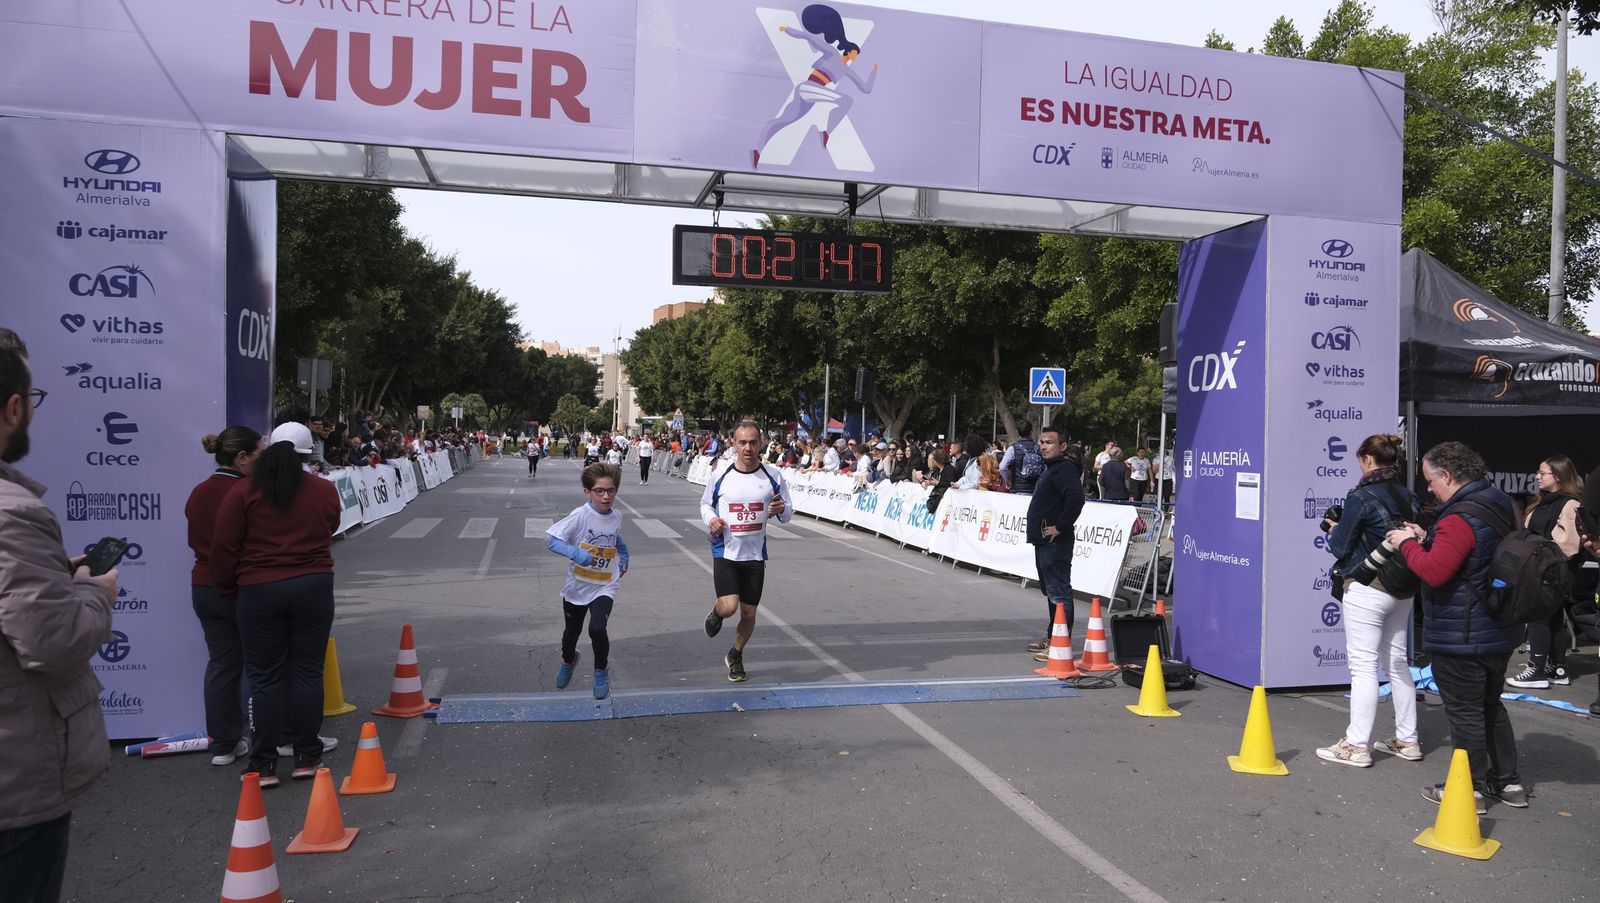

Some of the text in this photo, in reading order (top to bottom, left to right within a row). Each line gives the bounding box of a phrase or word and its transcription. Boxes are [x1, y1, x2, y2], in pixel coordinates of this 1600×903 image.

[468, 0, 515, 28] DE
[529, 2, 574, 34] LA
[248, 19, 591, 124] MUJER
[1063, 60, 1233, 102] LA IGUALDAD
[1020, 97, 1272, 145] ES NUESTRA META.
[1032, 142, 1077, 166] CDX
[1122, 150, 1169, 164] ALMERÍA
[1121, 161, 1147, 170] CIUDAD
[63, 176, 162, 193] HYUNDAI
[75, 192, 151, 207] Almerialva
[88, 224, 168, 242] cajamar
[711, 233, 883, 285] 00:21:47
[1308, 259, 1366, 272] HYUNDAI
[68, 272, 138, 298] CASI
[1315, 271, 1360, 282] Almerialva
[1322, 294, 1369, 308] cajamar
[92, 316, 164, 335] vithas
[91, 336, 109, 344] vivir
[130, 337, 164, 345] cuidarte
[238, 308, 271, 361] CDX
[1310, 331, 1351, 351] CASI
[1188, 340, 1247, 393] CDX
[1323, 364, 1365, 378] vithas
[78, 372, 162, 394] aqualia
[1314, 406, 1363, 423] aqualia
[86, 450, 141, 467] Clece
[1200, 449, 1251, 466] ALMERÍA
[1199, 467, 1225, 477] CIUDAD
[1316, 466, 1348, 478] Clece
[88, 491, 162, 520] AARÓN CASH
[854, 491, 878, 514] NEXA
[88, 507, 117, 520] PIEDRA
[737, 511, 757, 521] 873
[998, 513, 1028, 534] ALME
[112, 597, 149, 611] arón
[89, 663, 148, 672] RUTALMERÍA
